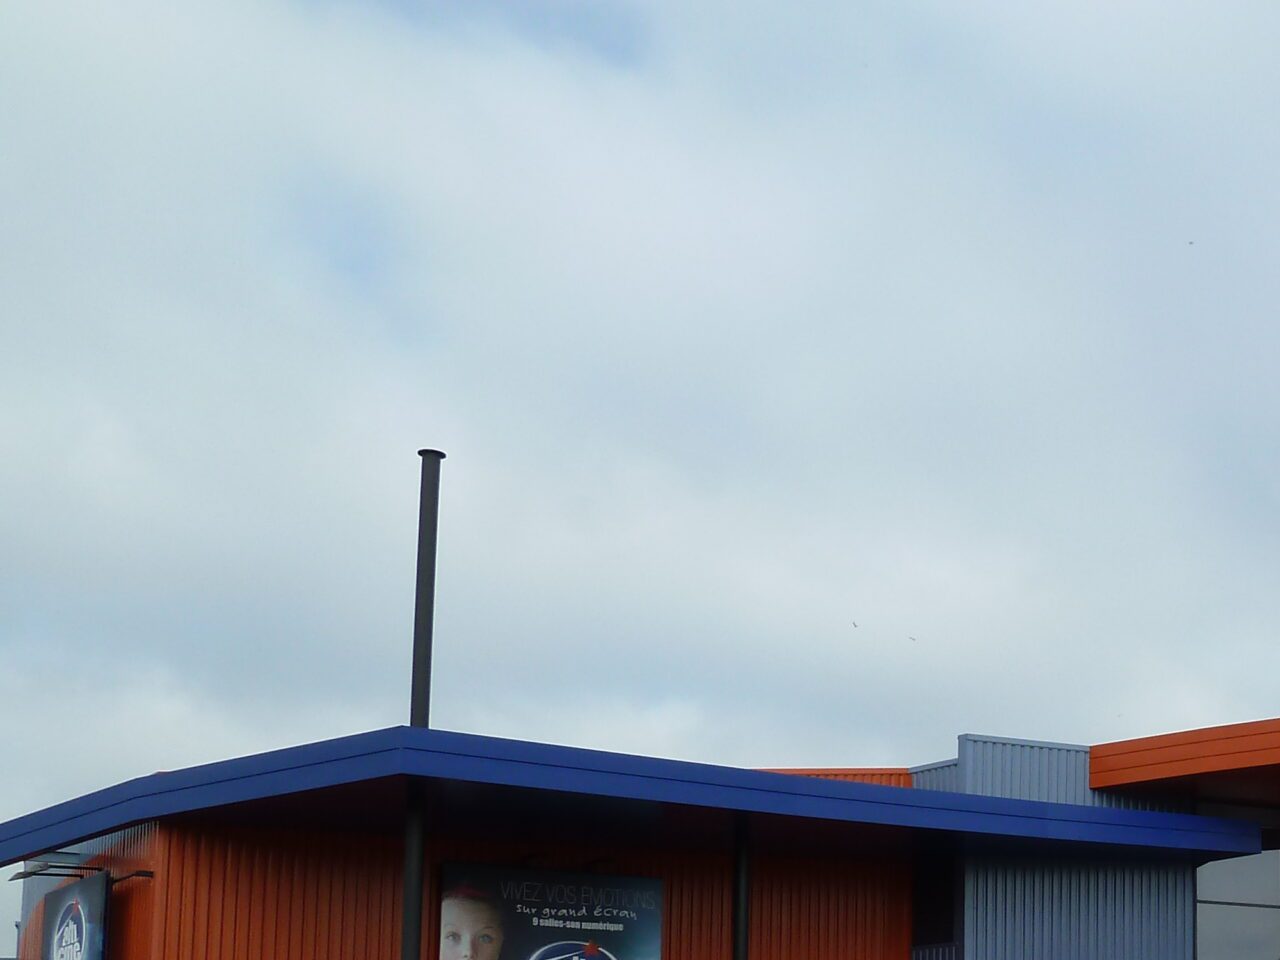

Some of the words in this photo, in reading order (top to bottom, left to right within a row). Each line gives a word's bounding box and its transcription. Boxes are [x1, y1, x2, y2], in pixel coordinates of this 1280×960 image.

[500, 882, 542, 901] VIVEZ
[546, 884, 576, 904] VOS
[515, 904, 537, 914] sur
[542, 906, 588, 918] grand
[532, 917, 538, 926] 9
